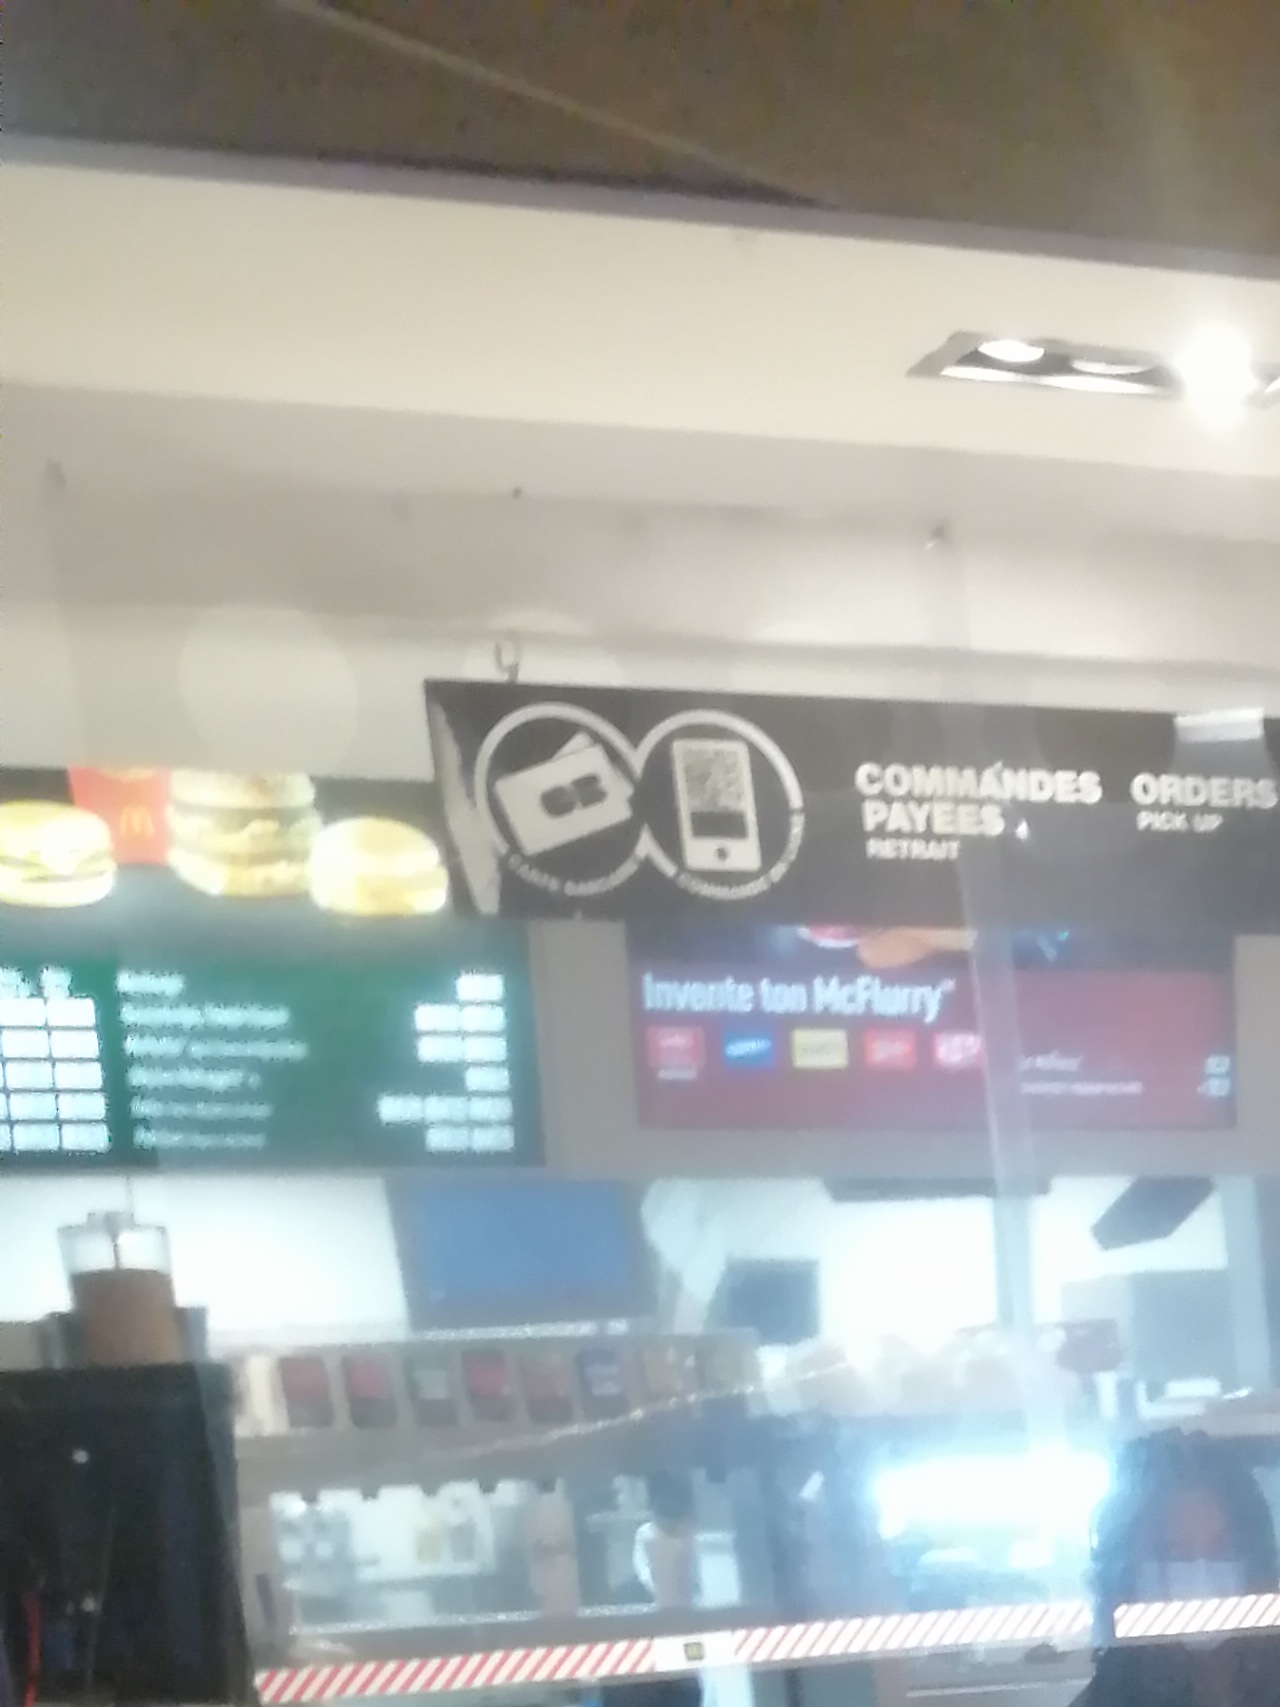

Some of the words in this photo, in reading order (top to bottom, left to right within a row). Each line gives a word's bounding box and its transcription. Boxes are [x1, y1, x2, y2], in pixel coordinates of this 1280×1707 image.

[854, 762, 1103, 804] COMMANDES
[1130, 771, 1279, 810] ORDERS
[1136, 810, 1188, 831] PICK
[864, 837, 961, 861] RETRAIT
[643, 972, 755, 1013] Invente
[760, 976, 807, 1014] ton
[813, 974, 943, 1025] McFlurry
